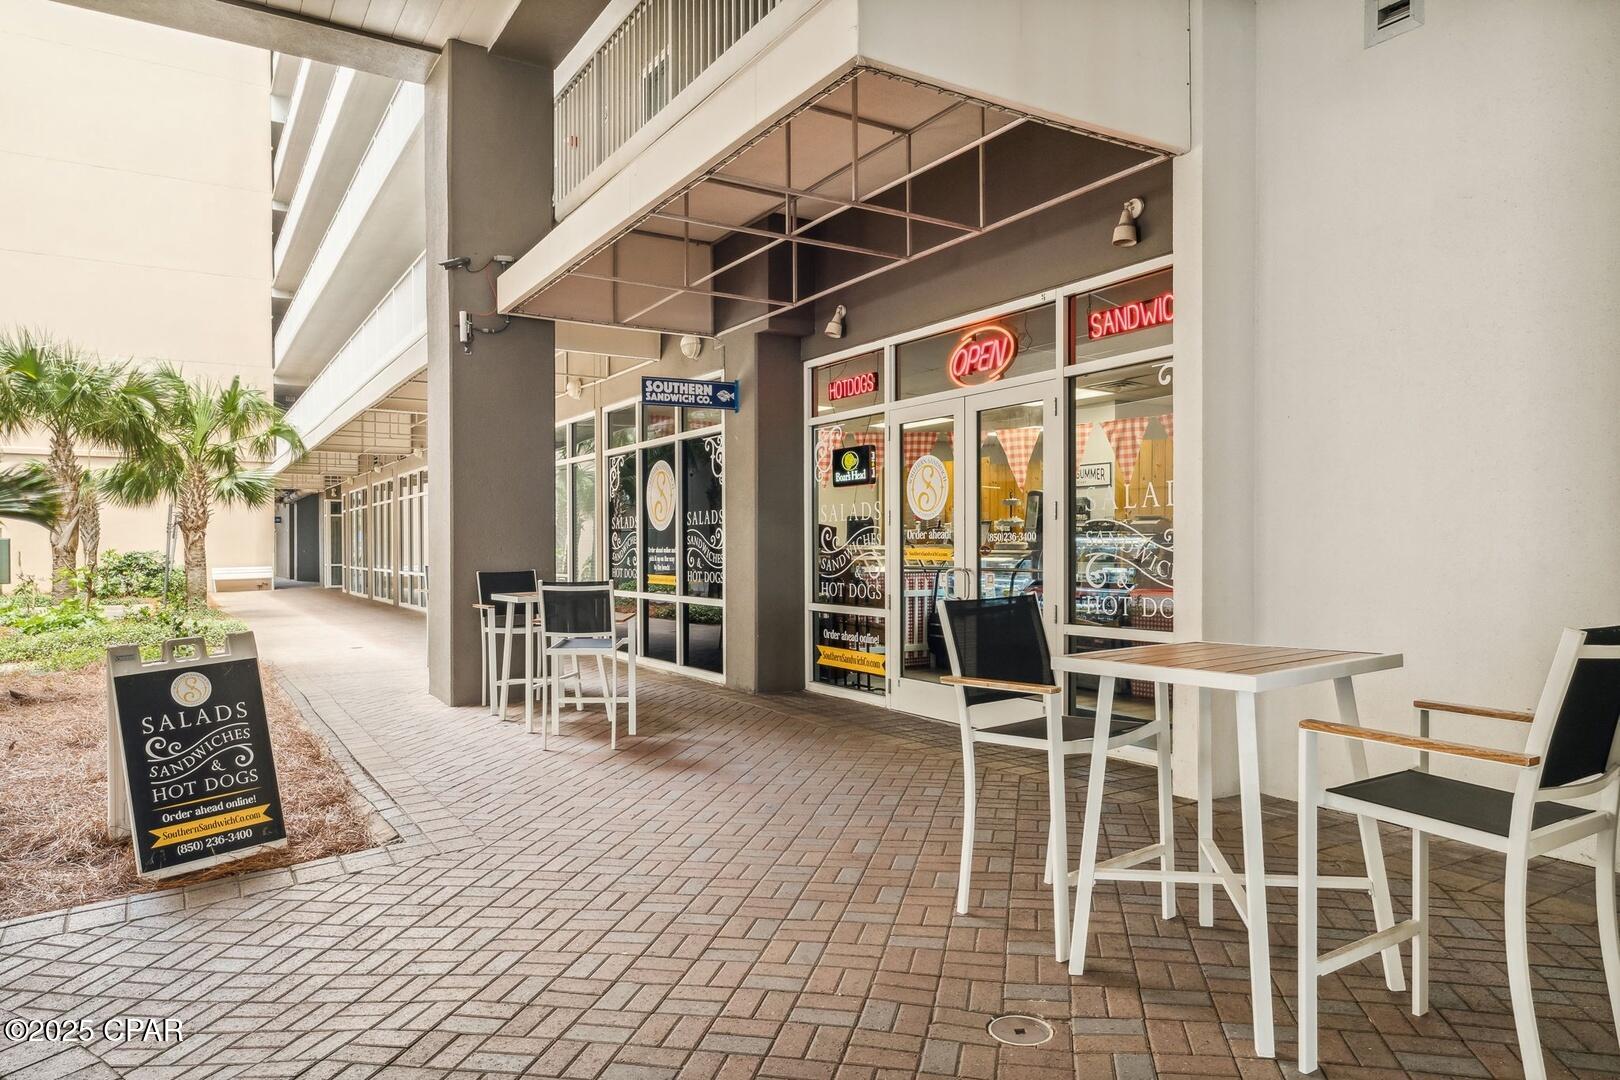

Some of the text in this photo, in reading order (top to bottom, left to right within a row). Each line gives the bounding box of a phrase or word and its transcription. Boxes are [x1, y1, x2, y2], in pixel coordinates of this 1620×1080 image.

[952, 338, 1008, 376] OPEN
[645, 380, 713, 396] SOUTHERN
[829, 373, 875, 400] HOTDOGS
[645, 393, 713, 405] SANDWICH CO.
[851, 468, 866, 480] Head
[687, 509, 724, 526] SALADS
[820, 501, 881, 523] SALADS
[907, 528, 952, 540] Order ahead
[820, 533, 882, 572] SANDWICHES
[687, 570, 703, 583] HOT
[820, 581, 882, 600] HOT DOGS
[1086, 595, 1133, 616] HOT
[823, 628, 840, 640] Order
[841, 630, 859, 641] ahead
[141, 701, 248, 735] SALADS
[149, 728, 251, 778] SANDWICHES
[211, 759, 227, 771] &
[152, 768, 259, 803] HOT DOGS
[162, 794, 257, 823] Order ahead online!
[162, 812, 261, 841] SouthernSandwichCo.com
[176, 828, 253, 856] (850) 236-3400
